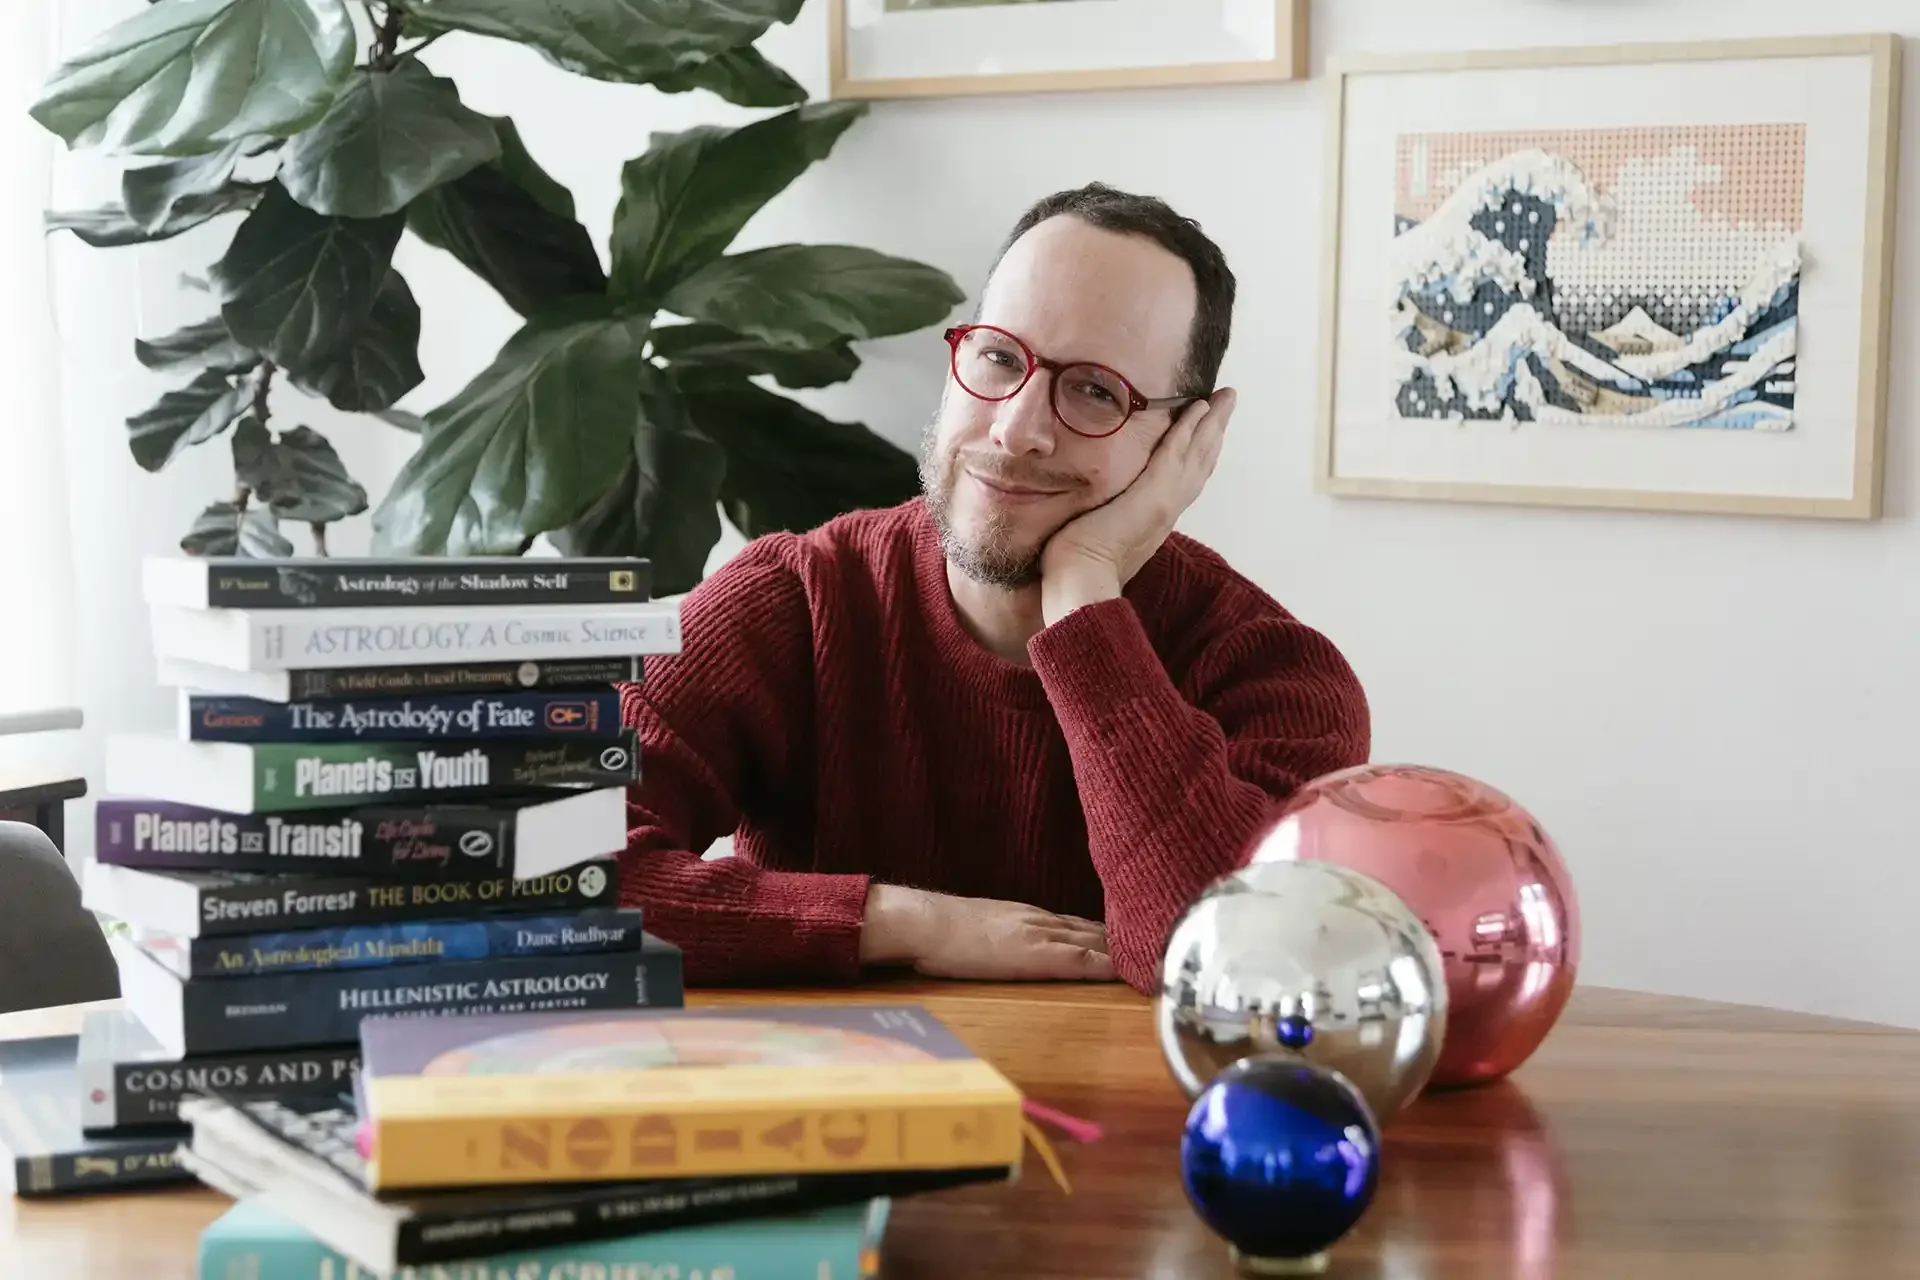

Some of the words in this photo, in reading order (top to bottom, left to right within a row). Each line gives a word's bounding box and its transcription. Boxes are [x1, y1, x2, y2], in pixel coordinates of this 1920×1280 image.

[334, 575, 420, 595] Astrology
[437, 577, 457, 590] the
[460, 573, 528, 589] Shadow
[533, 573, 568, 589] Self
[480, 624, 497, 646] A
[504, 620, 572, 646] Cosmic
[581, 618, 647, 643] Science
[289, 702, 335, 729] The
[338, 701, 452, 735] Astrology
[456, 700, 484, 732] of
[487, 702, 534, 728] Fate
[295, 756, 393, 797] Planets
[417, 748, 490, 789] Youth
[134, 813, 239, 854] Planets
[266, 817, 364, 859] Transit
[203, 896, 278, 921] Steven
[284, 890, 358, 914] Forrest
[368, 886, 405, 908] THE
[412, 882, 471, 905] BOOK
[478, 879, 505, 900] OF
[512, 874, 572, 897] PLUTO
[516, 930, 558, 948] Dane
[561, 925, 626, 946] Rudhyar
[340, 981, 479, 1010] HELLENISTIC
[483, 973, 610, 998] ASTROLOGY
[125, 1065, 249, 1094] COSMOS
[257, 1060, 322, 1085] AND
